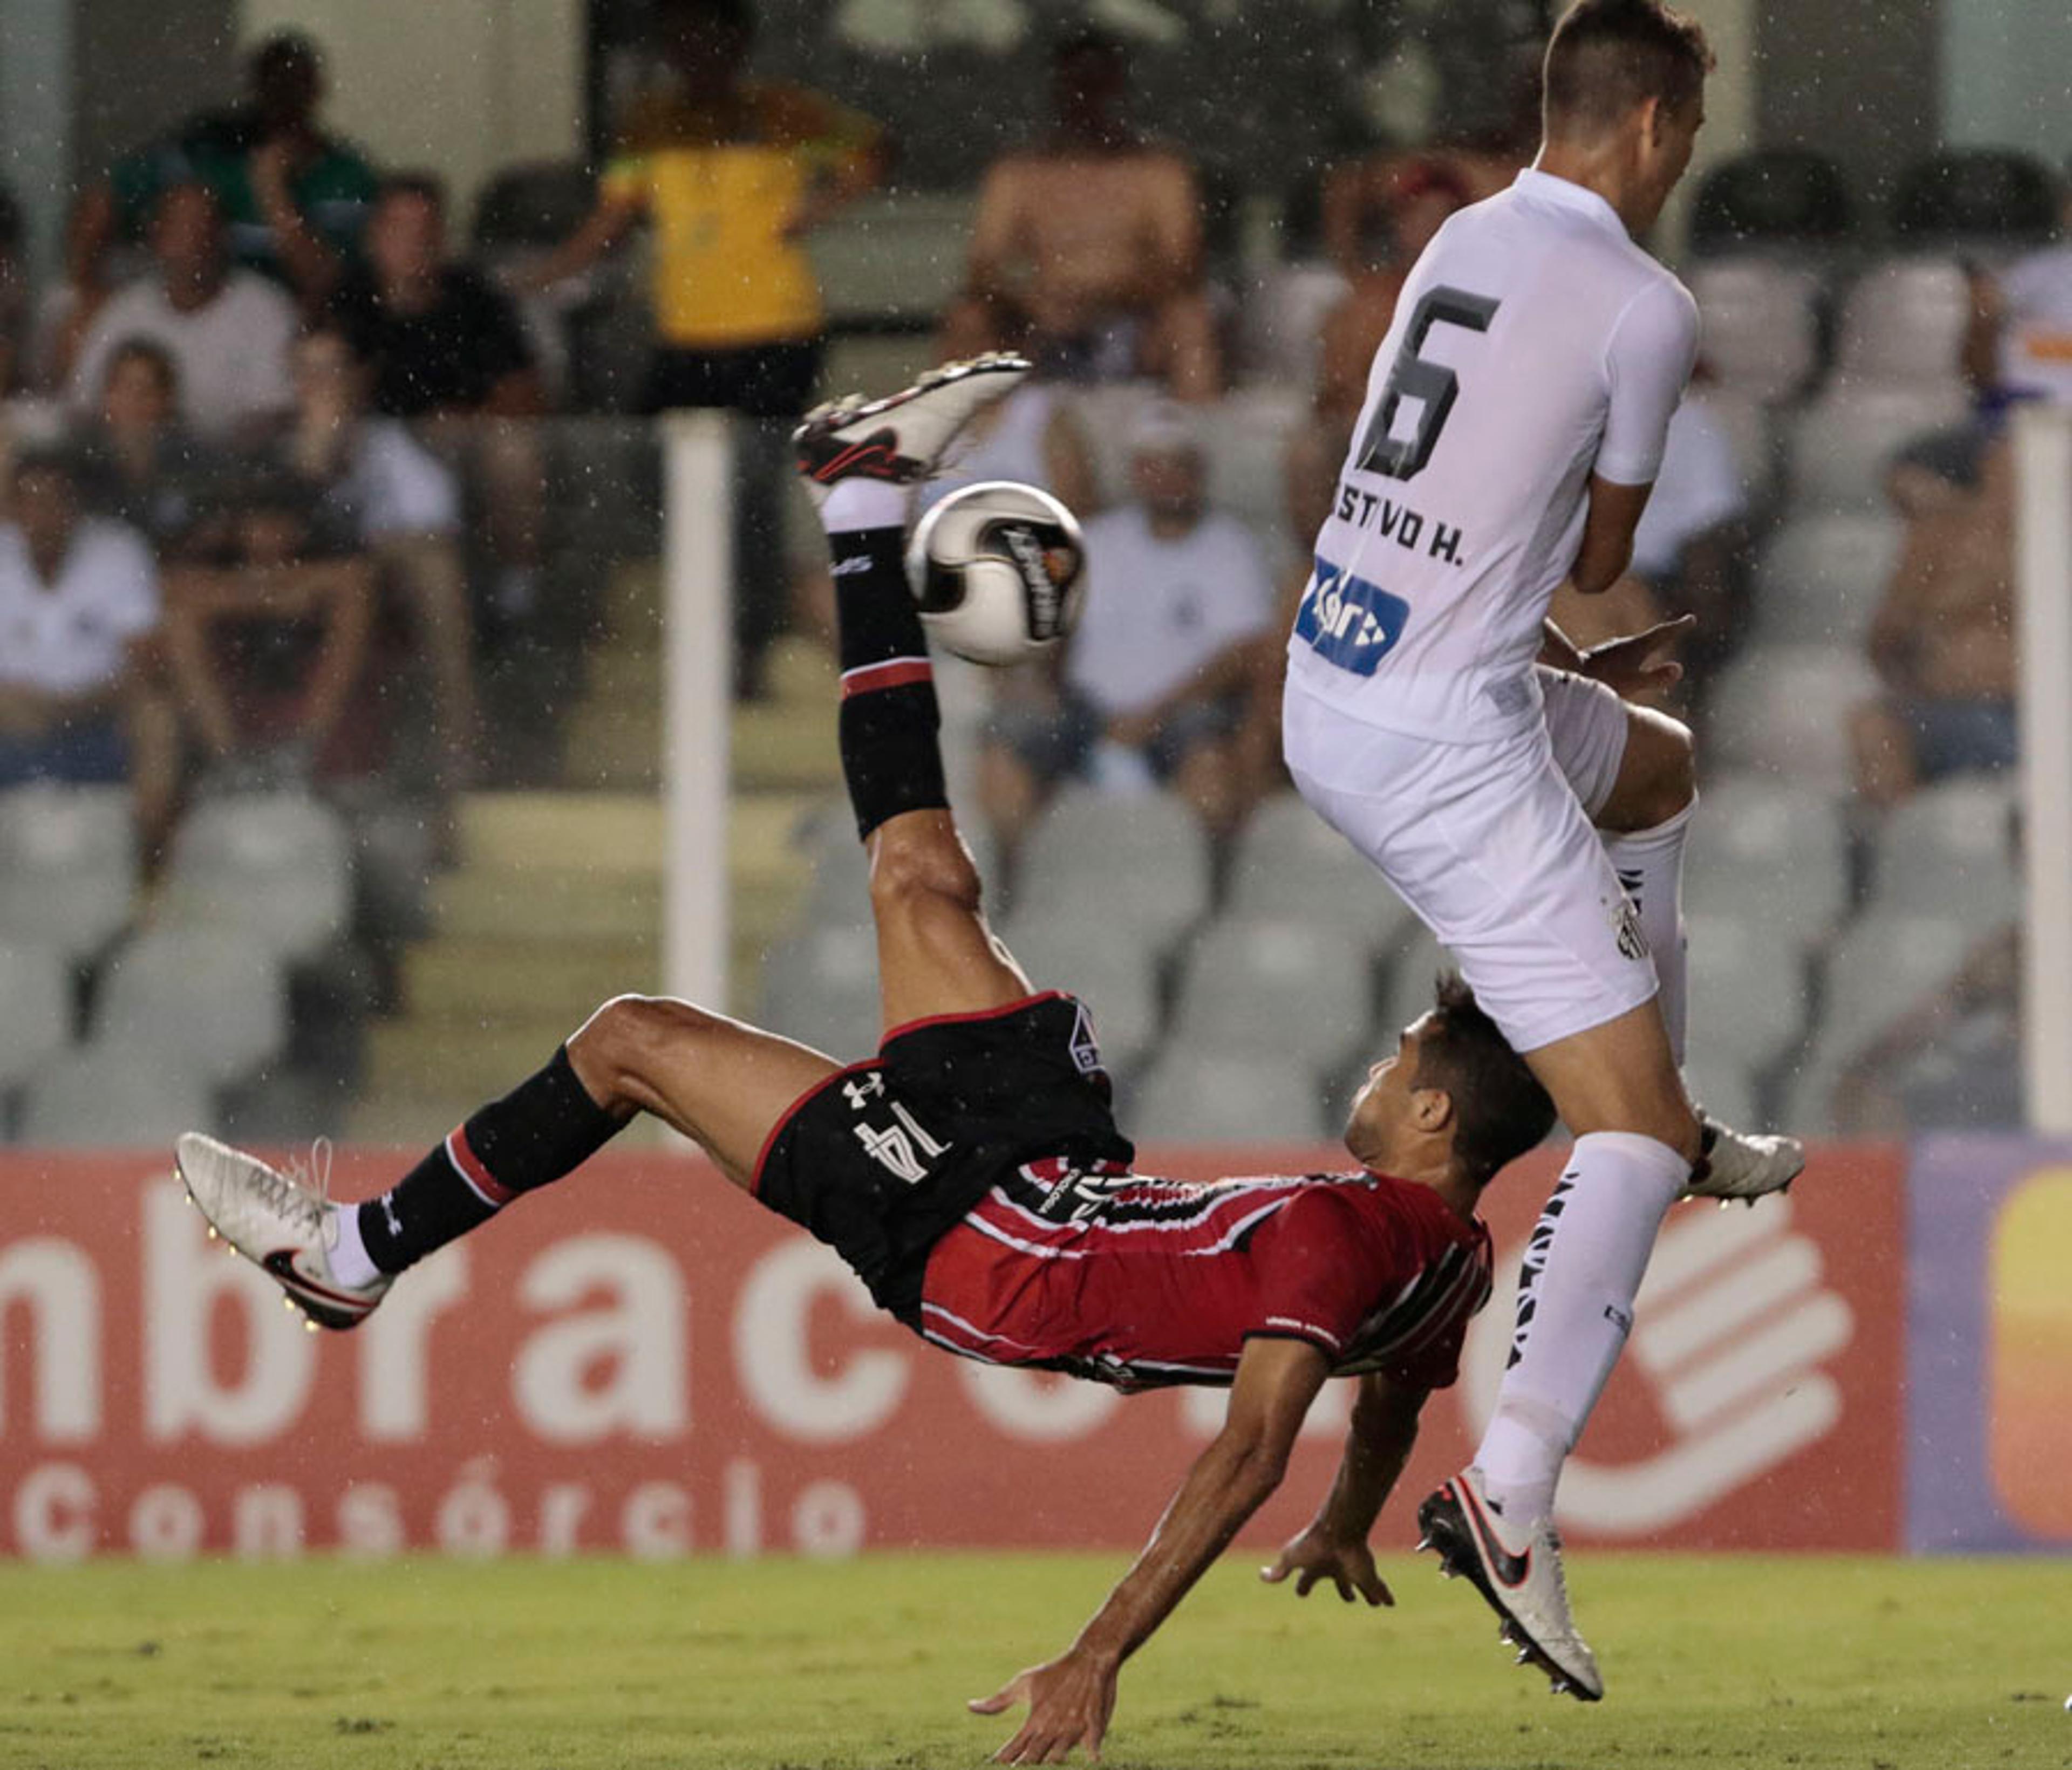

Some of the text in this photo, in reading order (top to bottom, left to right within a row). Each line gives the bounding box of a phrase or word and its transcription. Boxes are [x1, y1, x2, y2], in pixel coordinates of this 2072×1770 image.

[1355, 285, 1501, 482] 6
[1429, 523, 1462, 566] H.
[853, 1101, 953, 1184] 14
